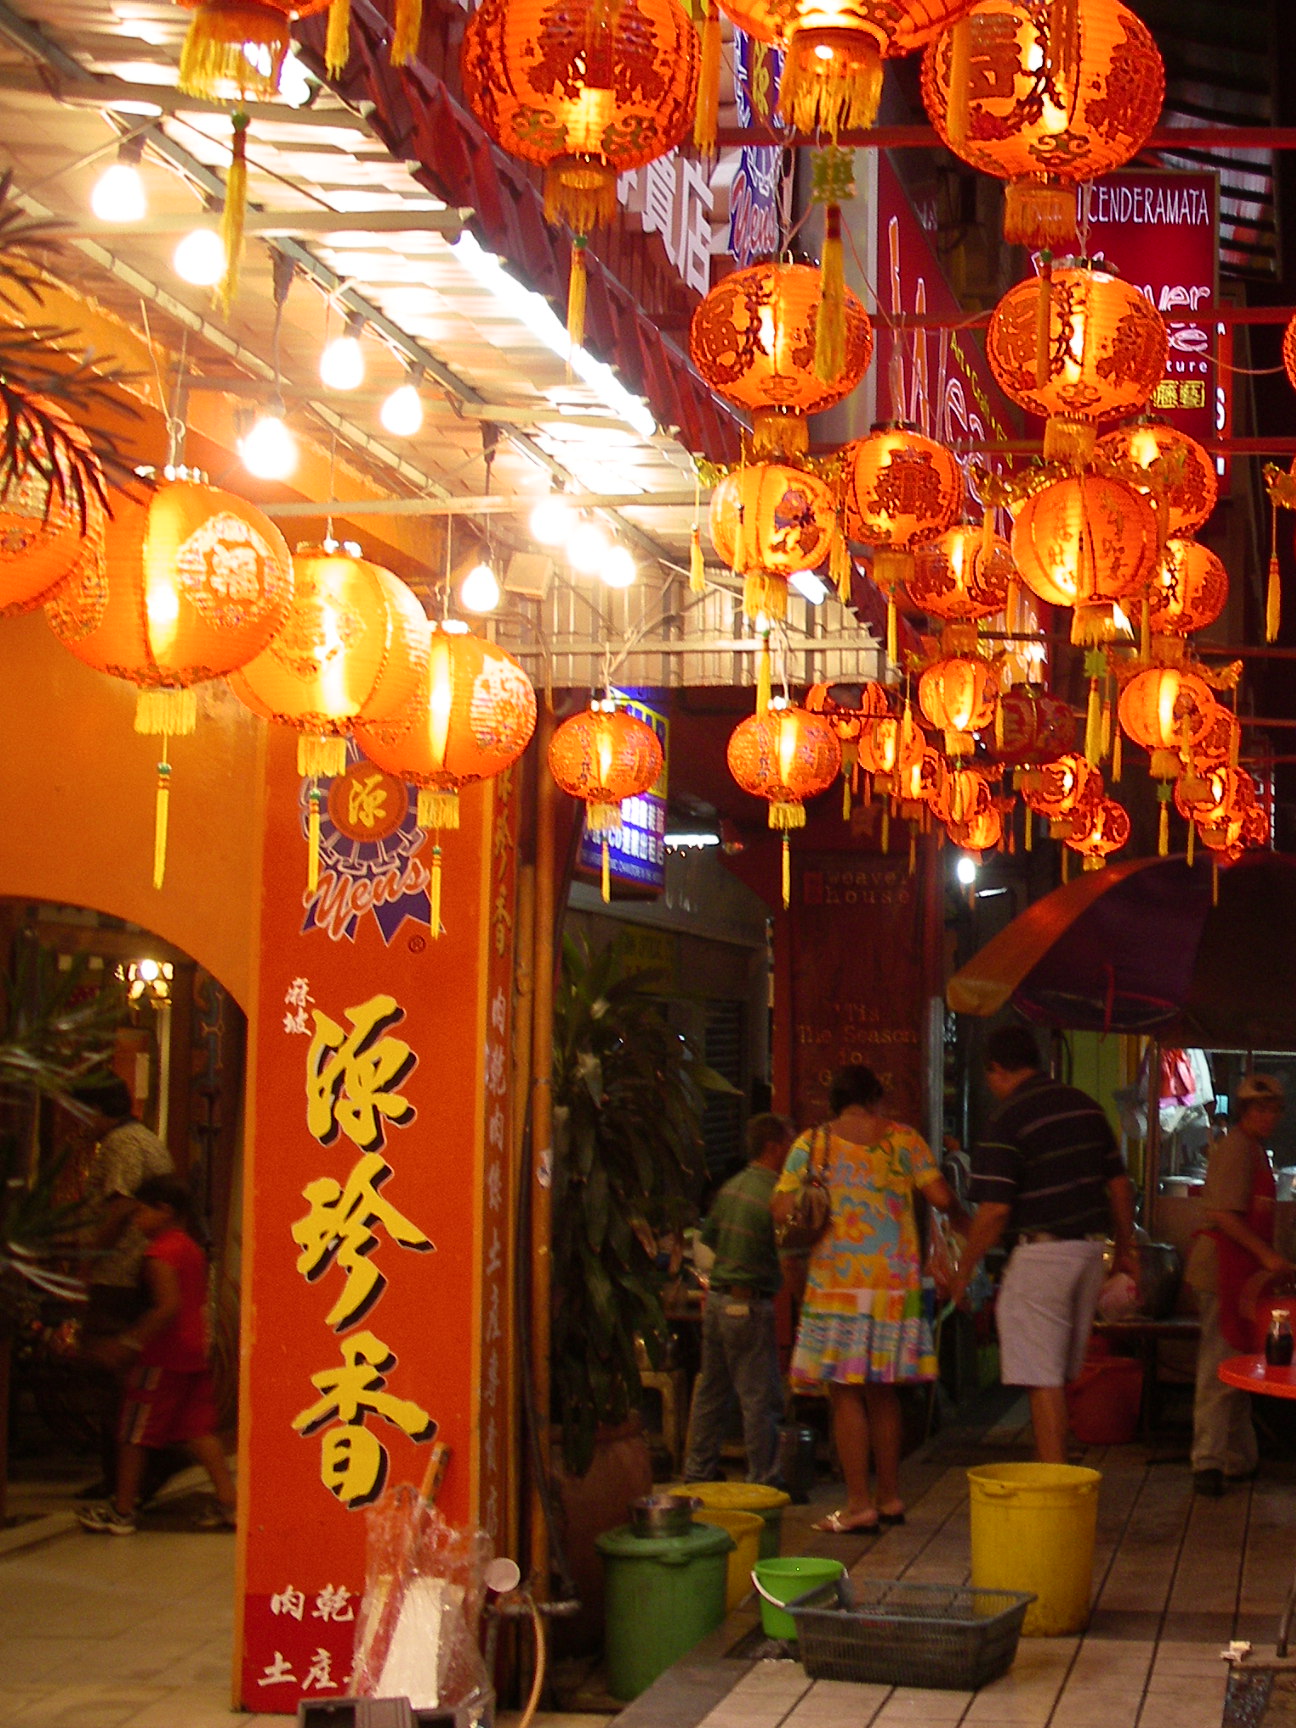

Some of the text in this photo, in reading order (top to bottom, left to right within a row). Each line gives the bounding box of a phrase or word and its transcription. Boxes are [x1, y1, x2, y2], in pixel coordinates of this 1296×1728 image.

[1087, 186, 1210, 225] CENDERAMATA
[303, 858, 430, 942] Yens
[826, 886, 910, 905] house
[283, 976, 315, 1037] 麻坡
[291, 994, 441, 1512] 源珍香
[270, 1583, 356, 1623] 肉乾
[257, 1647, 352, 1691] 土產
